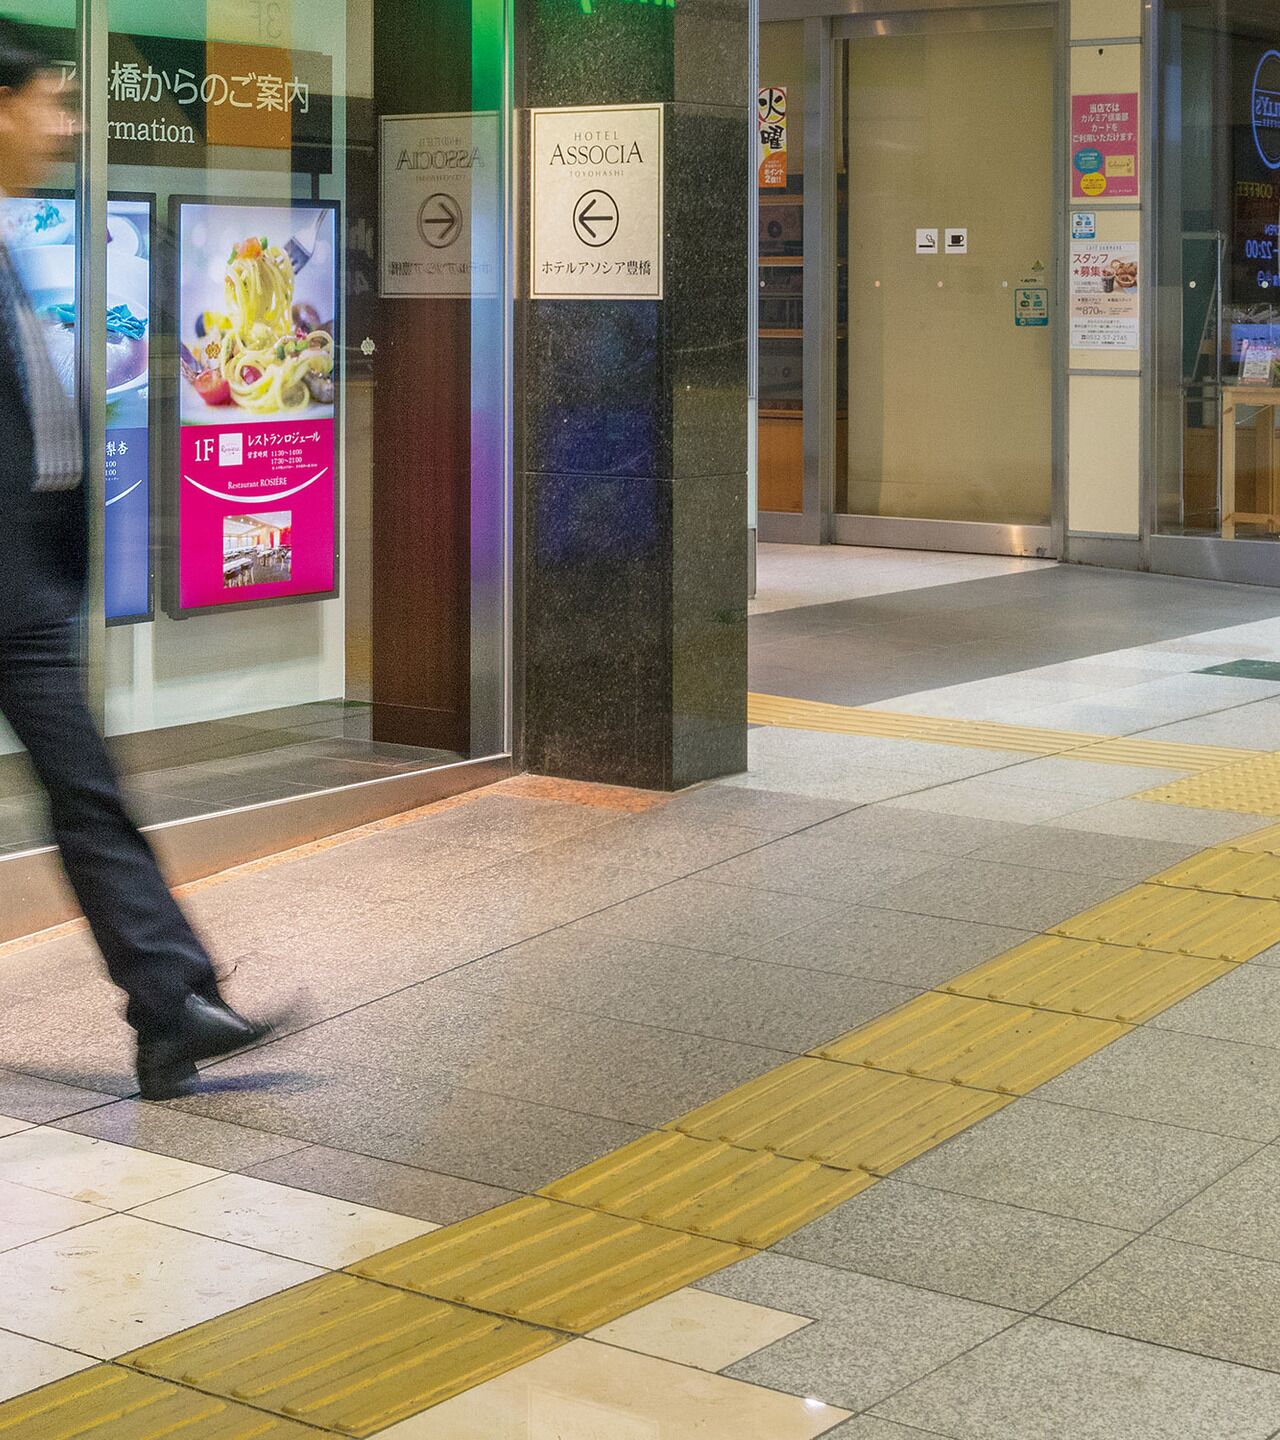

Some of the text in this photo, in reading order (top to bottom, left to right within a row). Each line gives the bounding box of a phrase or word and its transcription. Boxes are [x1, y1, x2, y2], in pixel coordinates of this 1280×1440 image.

[573, 130, 620, 142] HOTEL
[549, 140, 644, 166] ASSOCIA
[569, 169, 625, 178] TOYOHASHI
[1073, 253, 1109, 264] スタッフ
[541, 260, 651, 277] ホテルアソシア豊橋
[247, 431, 321, 447] レストランロジェール
[194, 439, 215, 462] 1F
